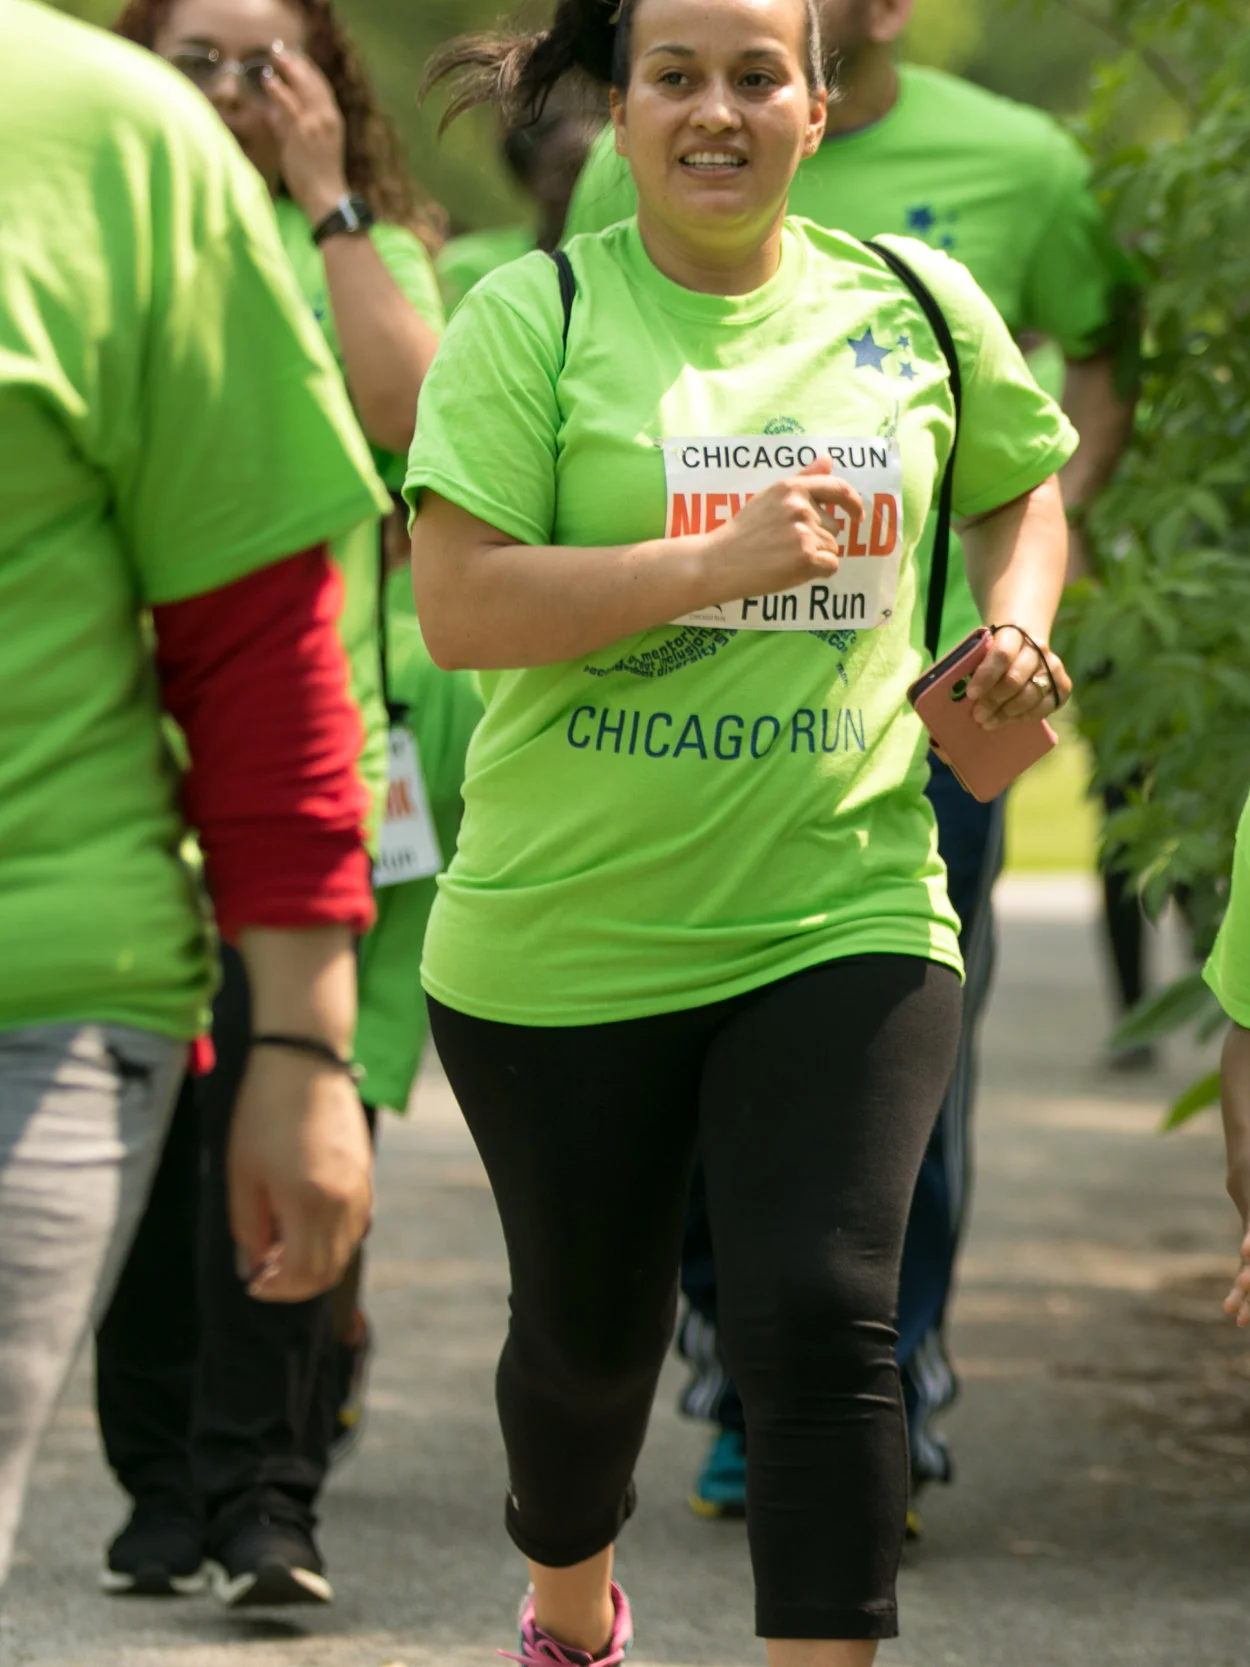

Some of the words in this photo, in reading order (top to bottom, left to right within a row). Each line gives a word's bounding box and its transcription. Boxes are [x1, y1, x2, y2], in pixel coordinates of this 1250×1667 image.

[681, 445, 817, 469] CHICAGO
[827, 446, 887, 468] RUN
[809, 585, 865, 620] Run
[566, 705, 781, 761] CHICAGO
[790, 708, 867, 754] RUN
